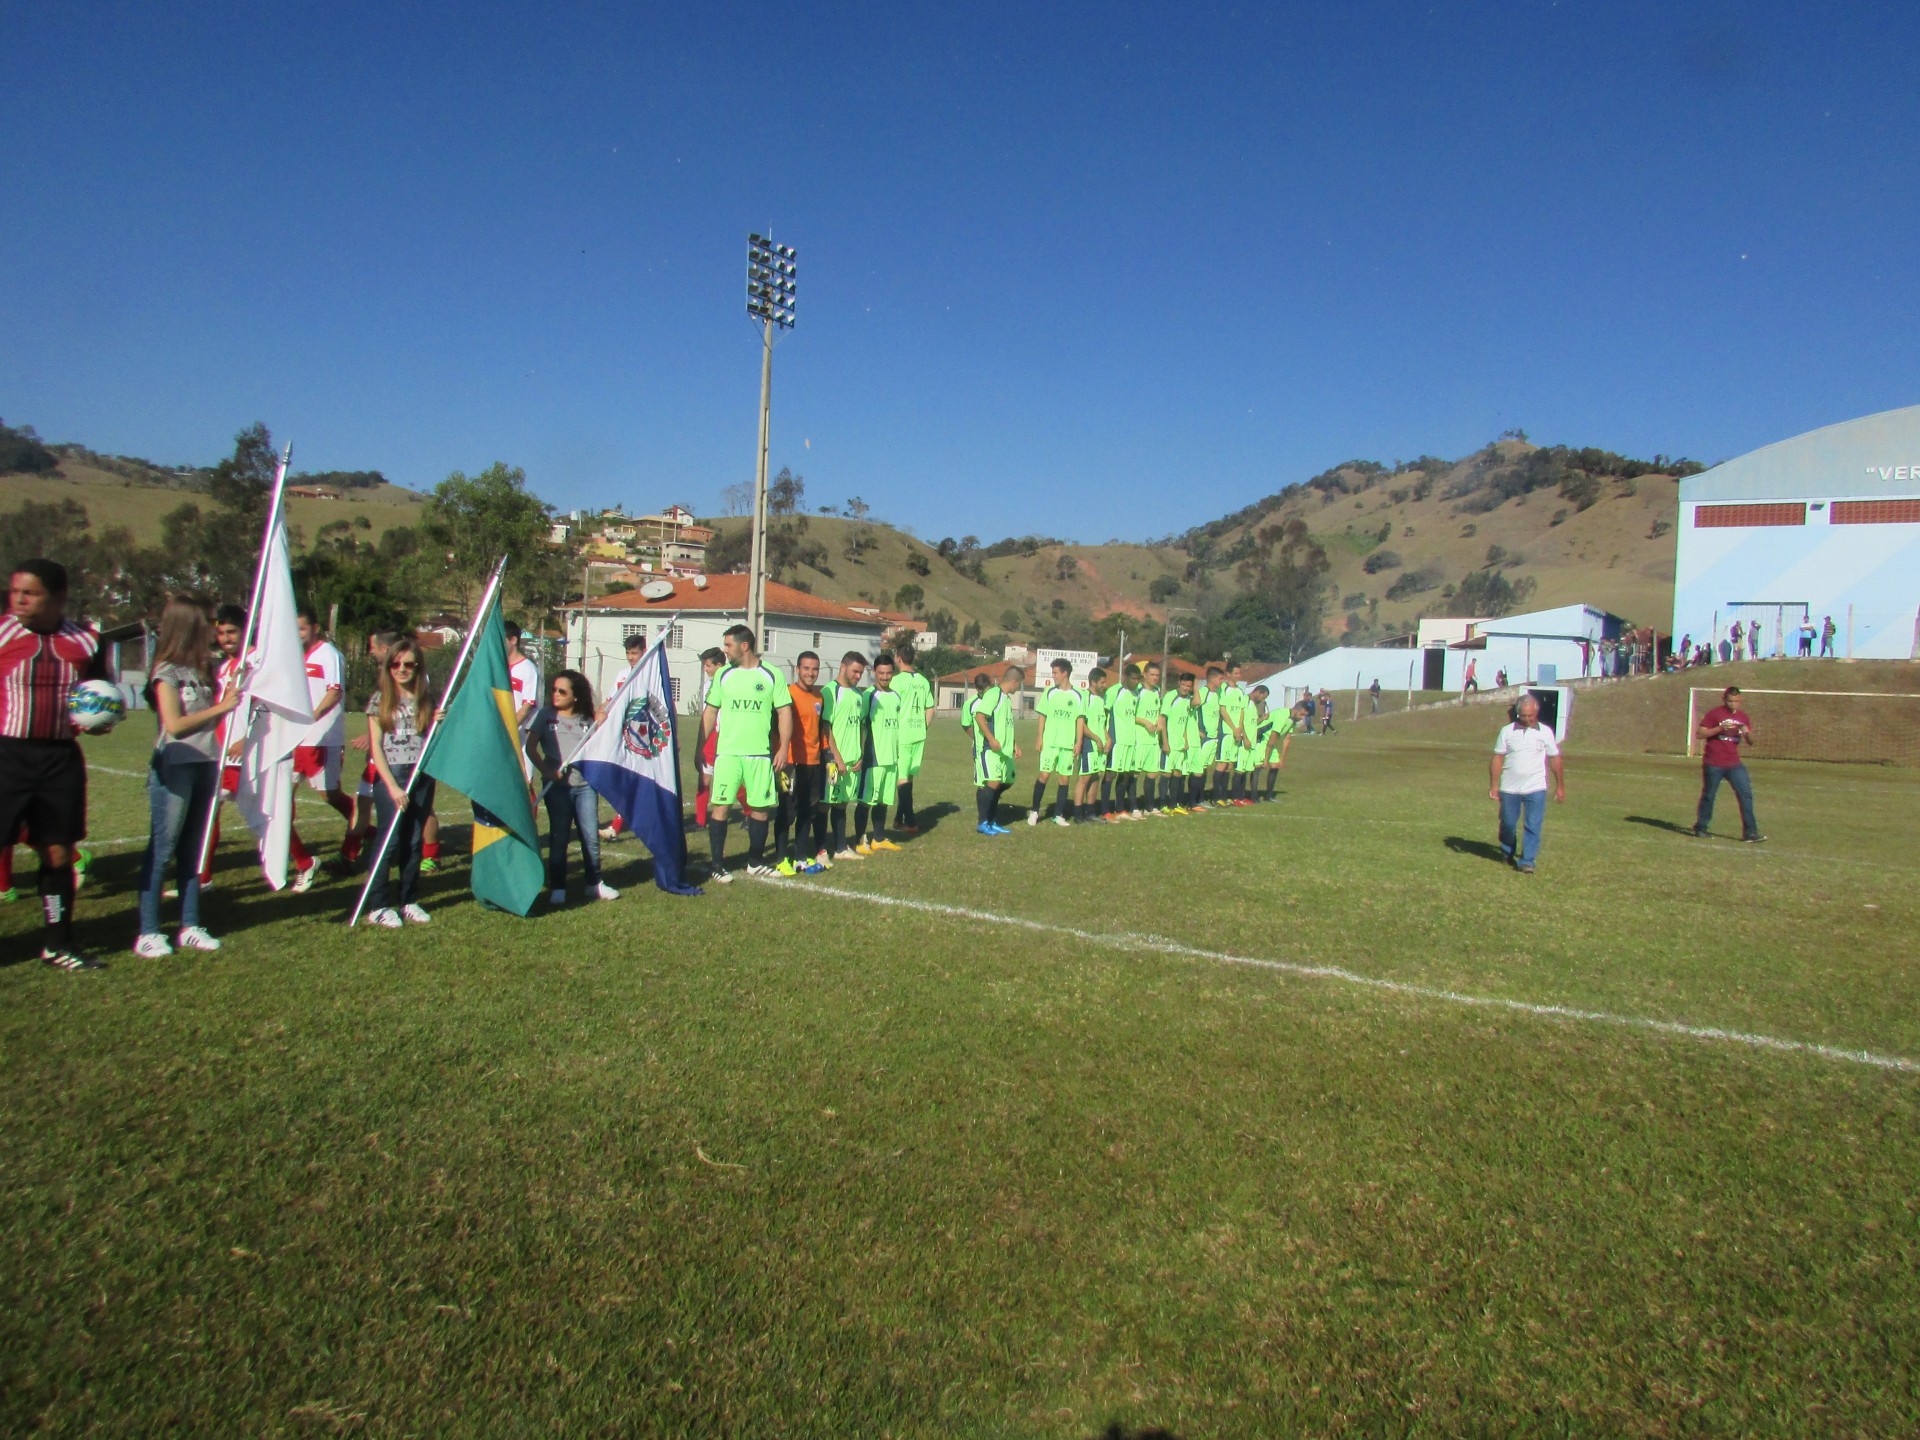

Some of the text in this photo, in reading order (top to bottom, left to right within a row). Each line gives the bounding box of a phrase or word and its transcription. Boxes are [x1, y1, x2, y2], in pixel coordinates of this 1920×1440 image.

[731, 699, 763, 711] NVN
[912, 691, 921, 714] 4
[1053, 709, 1073, 719] NVN
[719, 783, 728, 797] 7
